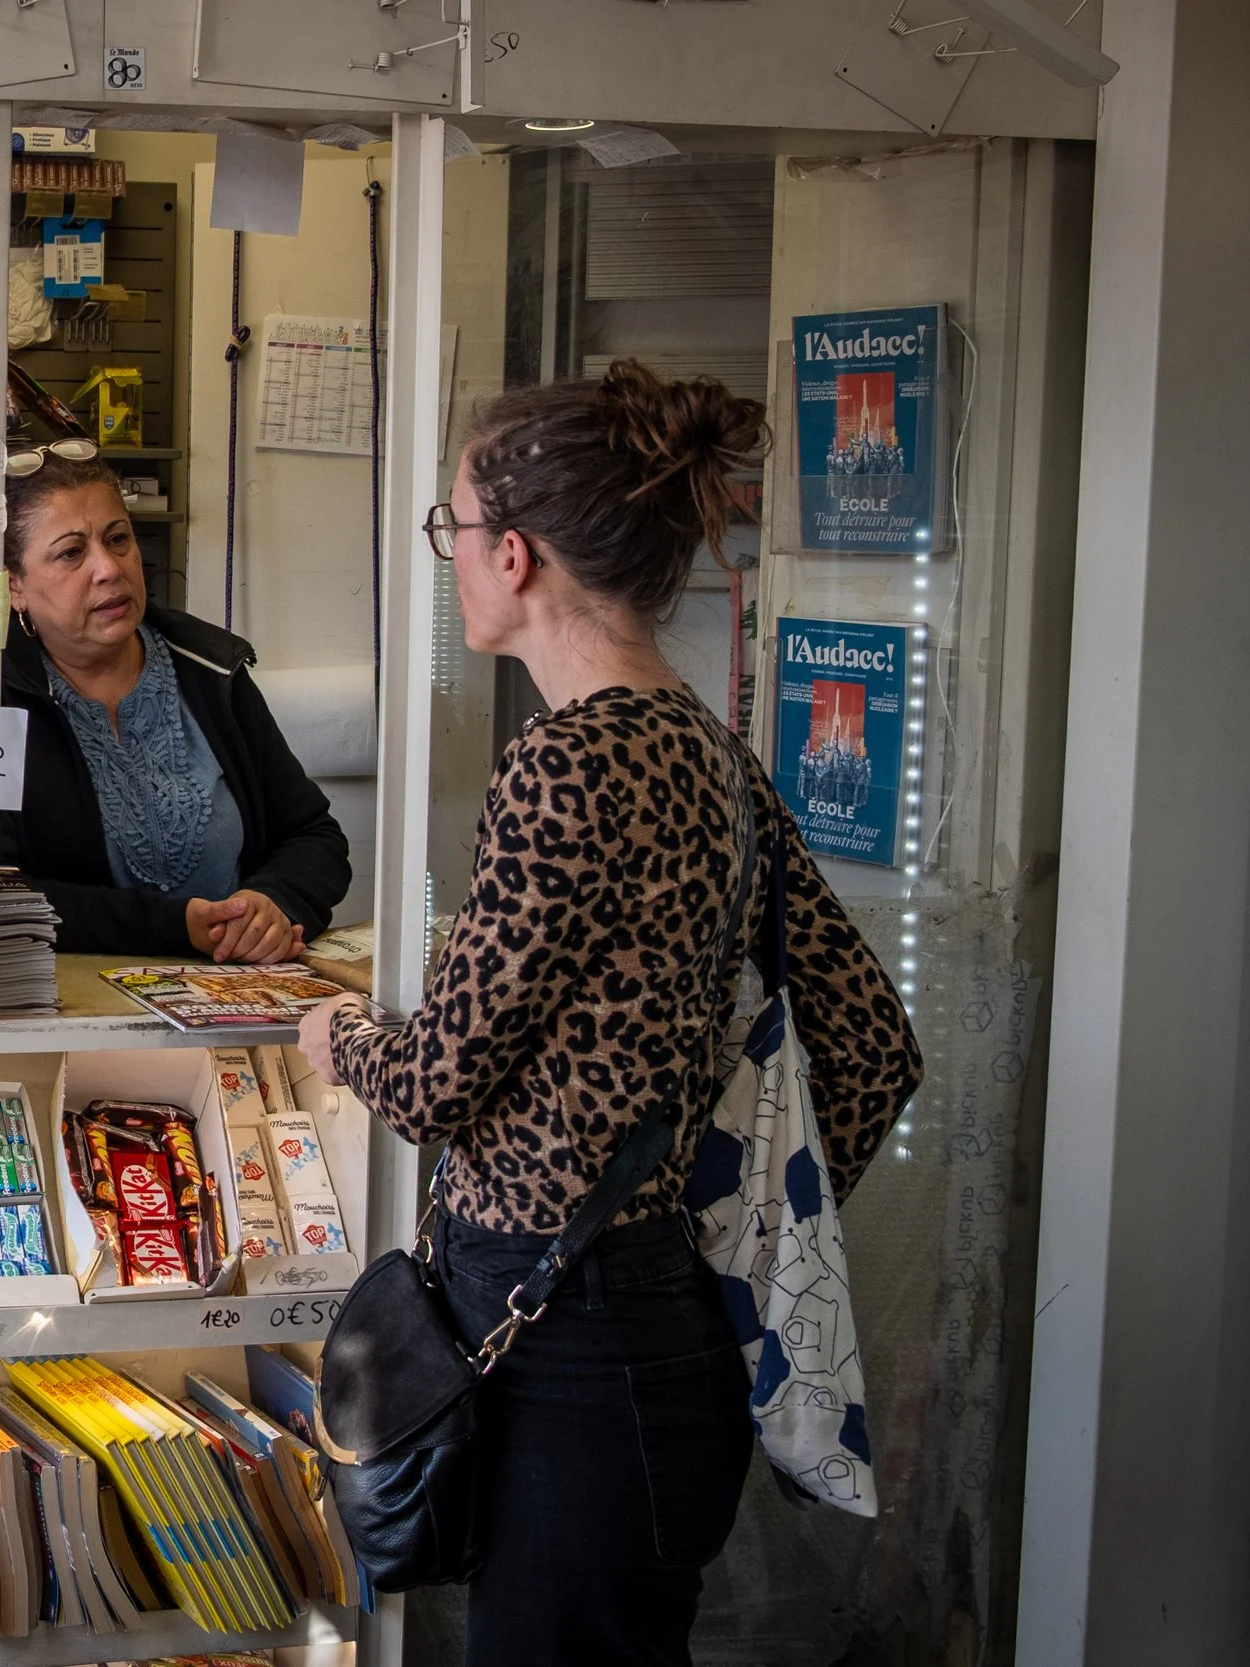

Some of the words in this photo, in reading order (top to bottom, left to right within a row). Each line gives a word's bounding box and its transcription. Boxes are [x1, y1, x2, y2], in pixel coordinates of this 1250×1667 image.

[839, 496, 889, 512] ÉCOLE
[814, 512, 840, 527] Tout
[842, 511, 887, 527] détruire
[889, 515, 917, 532] pour
[818, 528, 841, 541] tout
[843, 527, 910, 543] reconstruire
[808, 799, 855, 819] ÉCOLE
[809, 813, 854, 834] détruire
[854, 823, 881, 839] pour
[809, 830, 875, 852] reconstruire
[269, 1119, 310, 1129] Mouchoirs
[282, 1141, 301, 1155] TOP
[306, 1227, 326, 1242] TOP
[201, 1310, 241, 1328] 1€20
